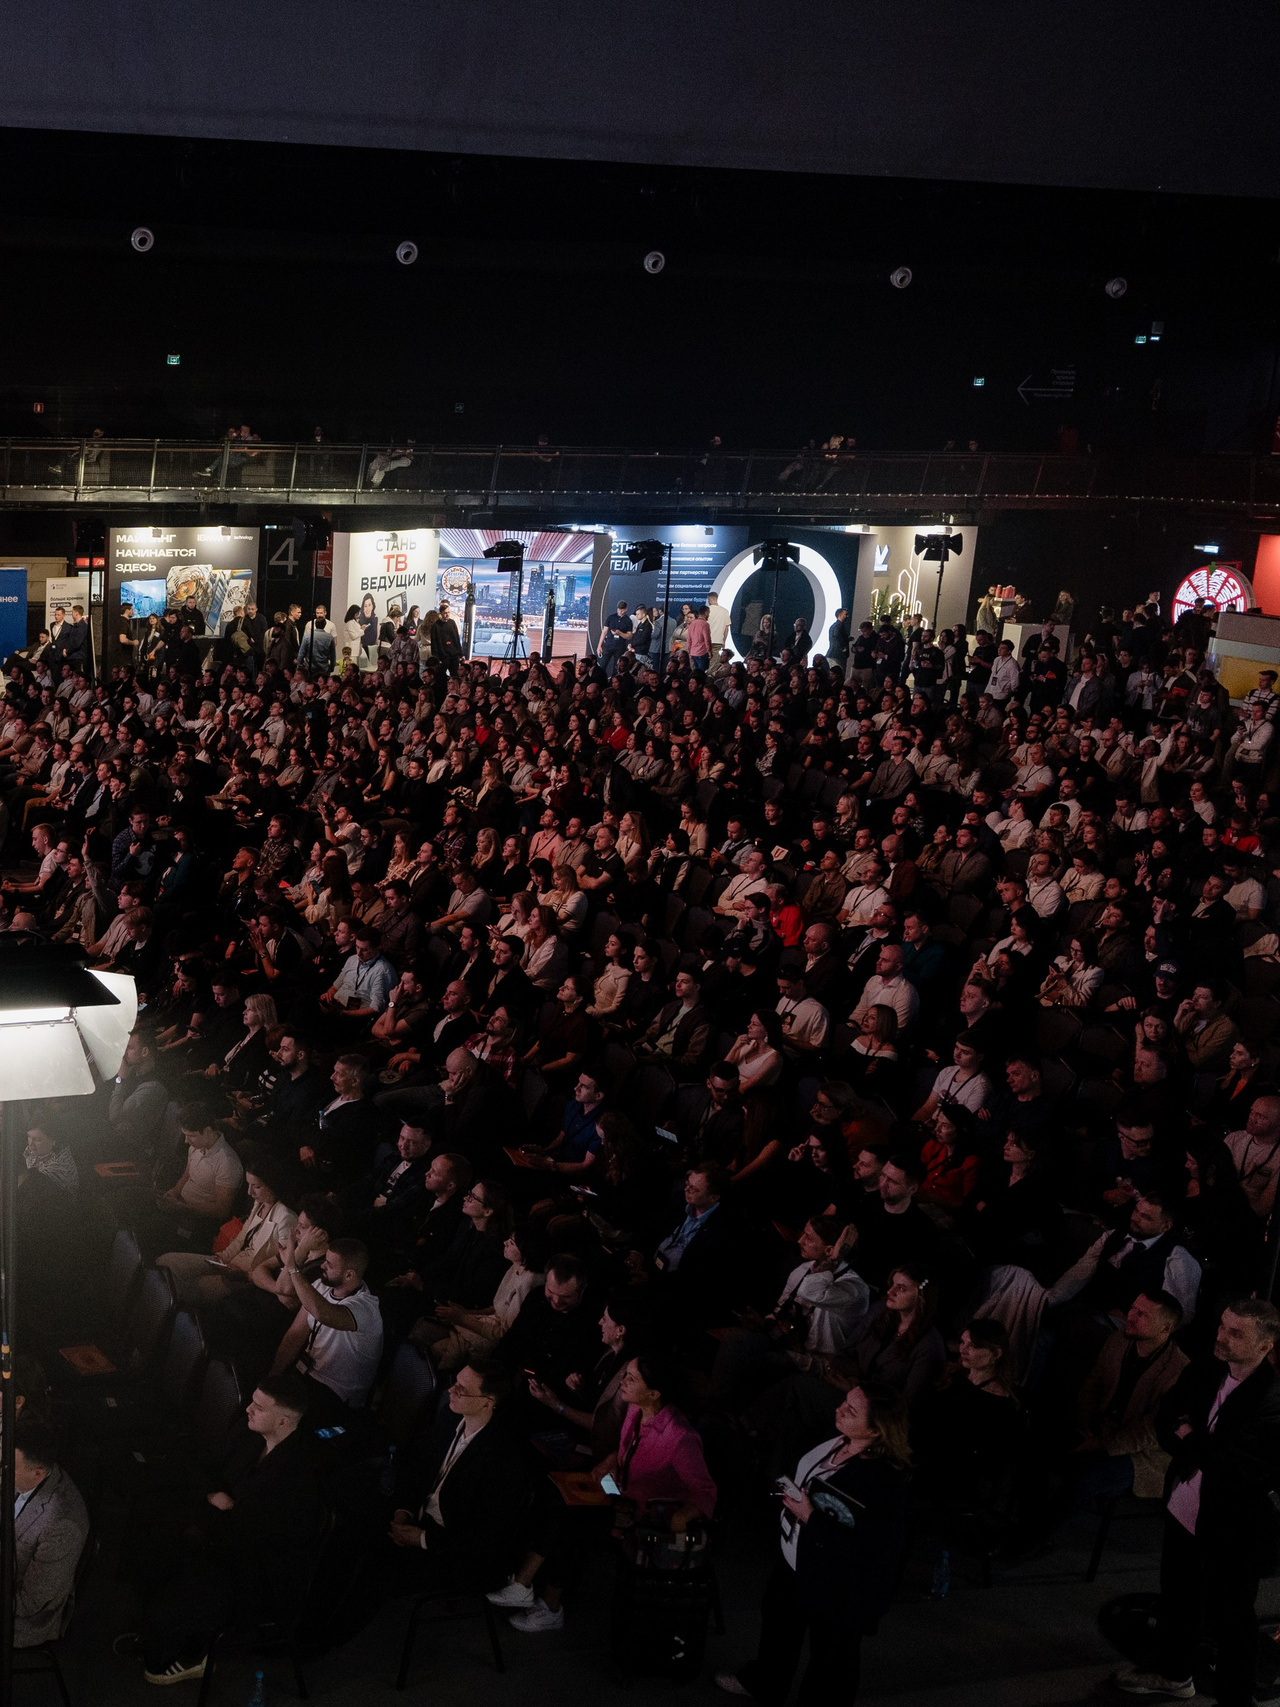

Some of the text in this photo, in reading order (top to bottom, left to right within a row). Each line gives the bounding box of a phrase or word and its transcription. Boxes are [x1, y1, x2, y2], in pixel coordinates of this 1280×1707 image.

[376, 538, 417, 551] СТАНЬ
[116, 548, 197, 558] НАЧИНАЕТСЯ
[269, 537, 298, 576] 4
[115, 563, 157, 573] ЗДЕСЬ
[383, 554, 408, 573] ТВ
[361, 573, 426, 592] ВЕДУЩИМ
